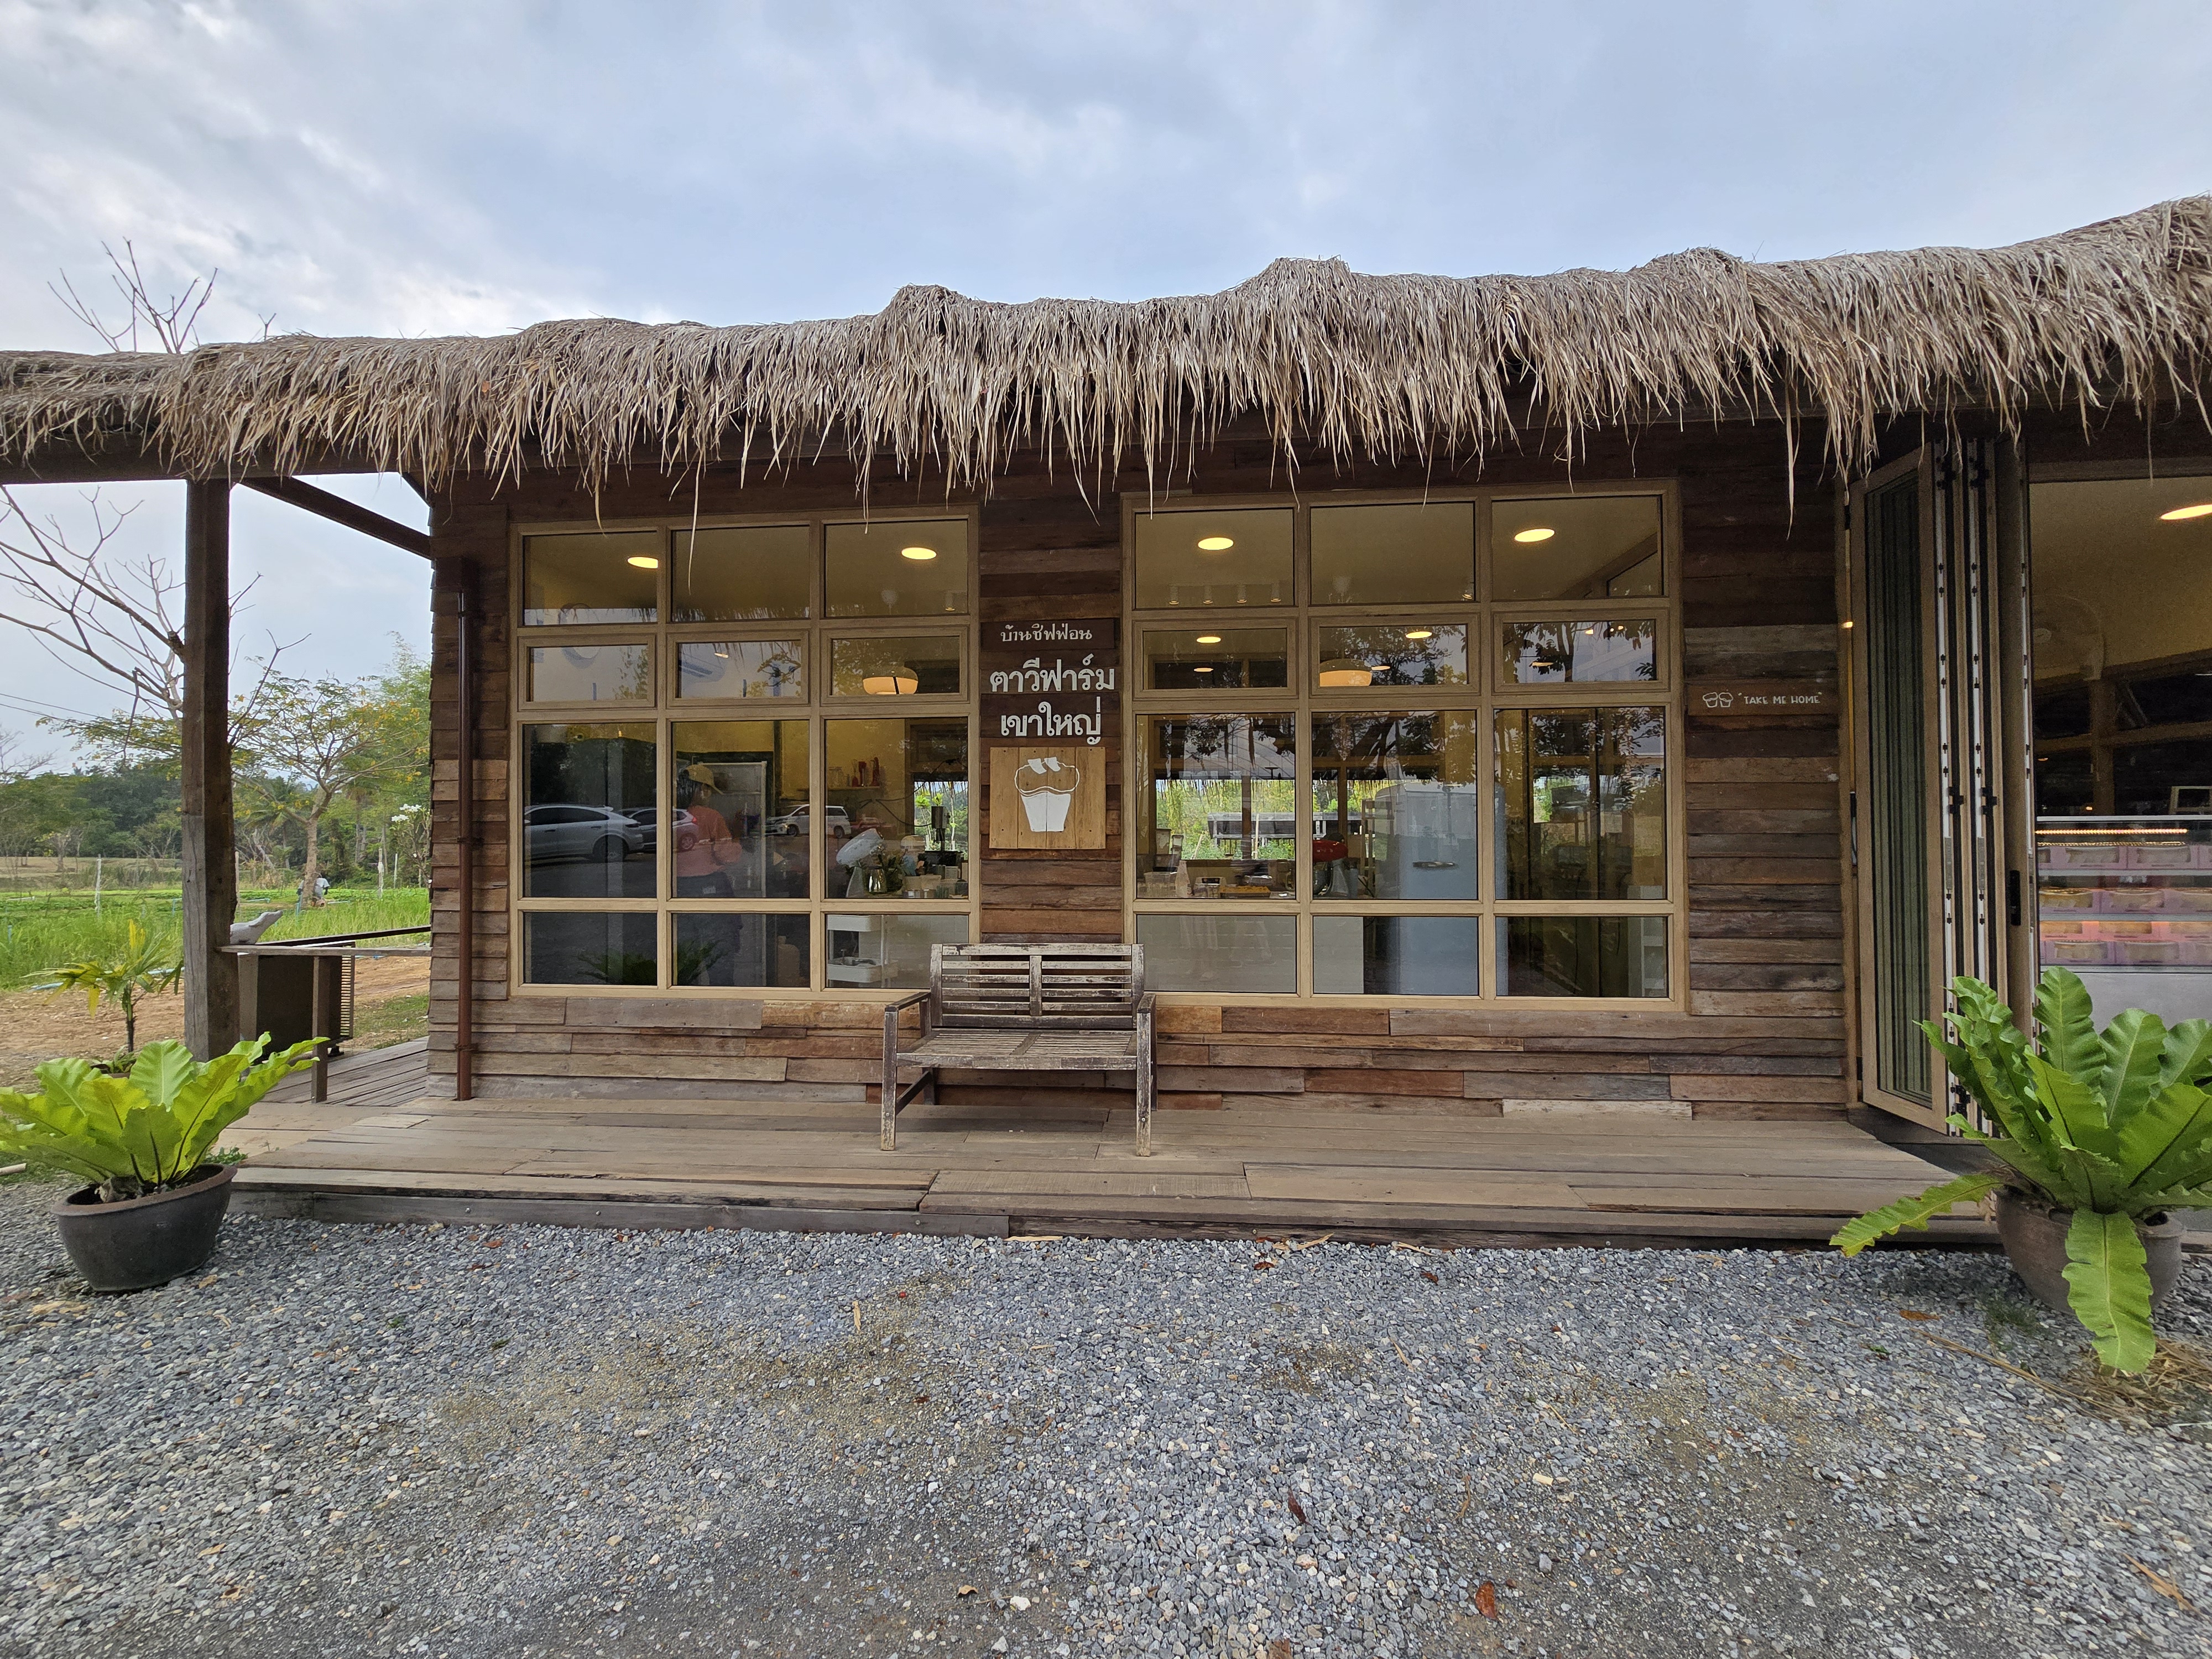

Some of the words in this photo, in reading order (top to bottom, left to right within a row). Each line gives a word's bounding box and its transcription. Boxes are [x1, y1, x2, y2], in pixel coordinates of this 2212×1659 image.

[1000, 623, 1093, 642] บ้านชิฟฟ่อน
[990, 653, 1114, 692] ตาวีฟาร์ม
[1744, 696, 1768, 705] TAKE
[1773, 696, 1787, 705] ME
[1791, 695, 1820, 704] HOME
[1001, 696, 1101, 745] เขาใหญ่
